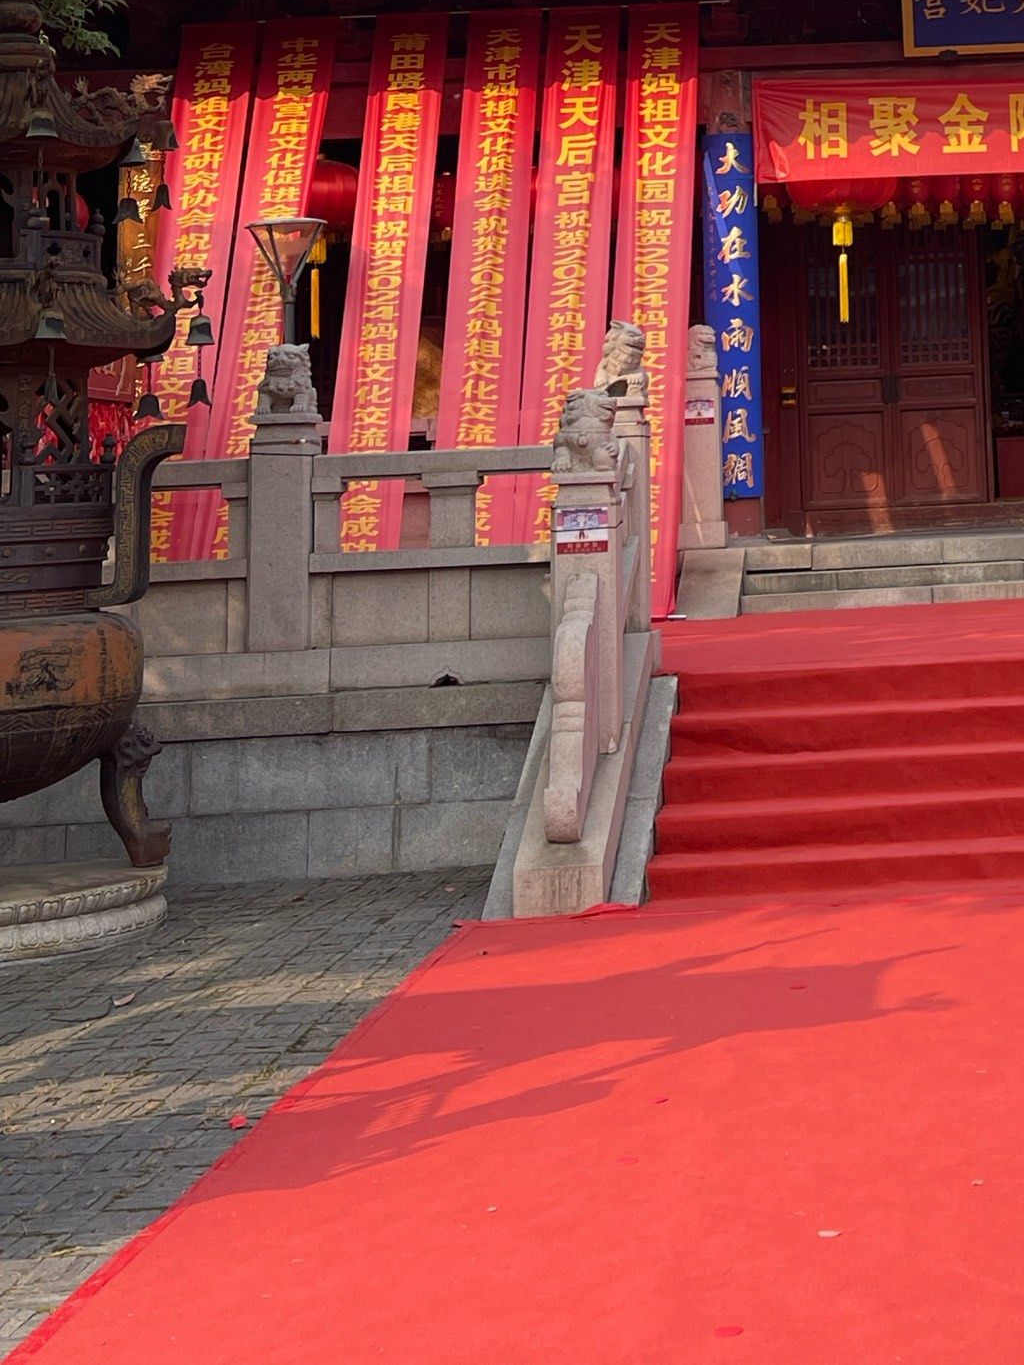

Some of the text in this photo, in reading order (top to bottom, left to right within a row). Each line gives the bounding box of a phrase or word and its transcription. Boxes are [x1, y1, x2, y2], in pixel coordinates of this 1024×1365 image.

[176, 43, 235, 228] 台湾妈祖文化研究协会
[371, 33, 430, 216] 莆田贤良港天后祖祠
[473, 29, 522, 212] 天津市妈祖文化促进会
[635, 22, 682, 203] 天津妈祖文化园
